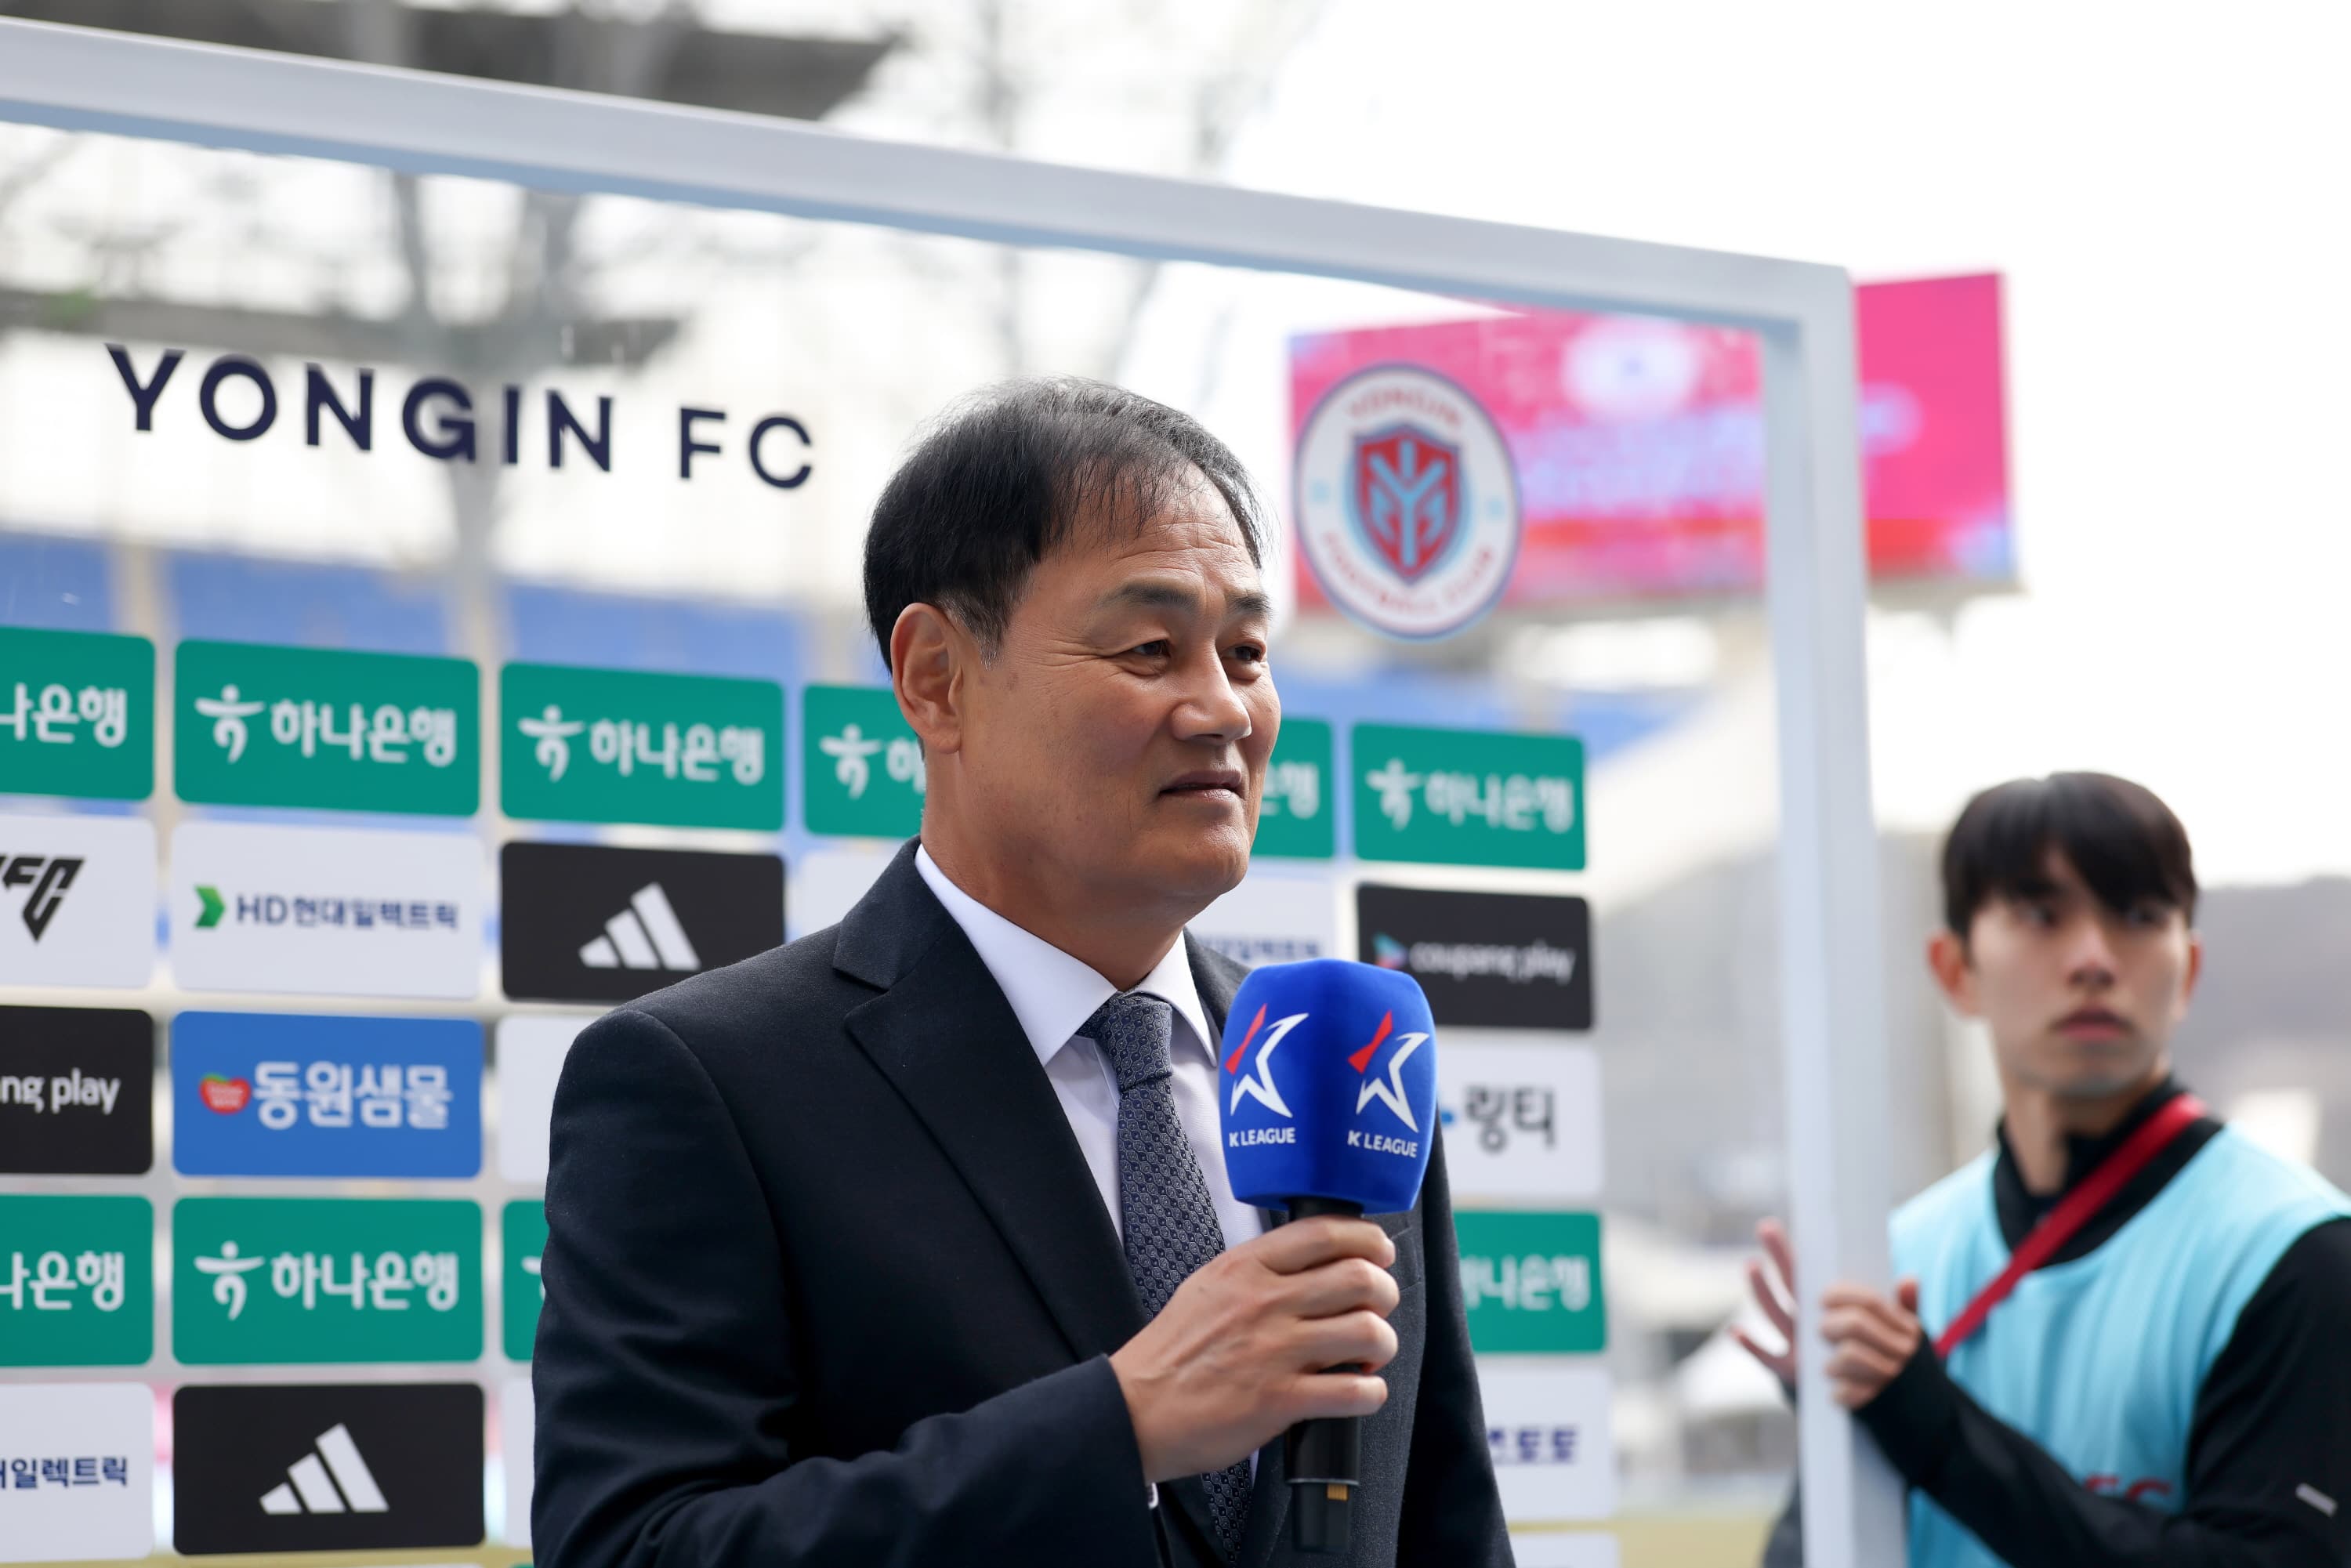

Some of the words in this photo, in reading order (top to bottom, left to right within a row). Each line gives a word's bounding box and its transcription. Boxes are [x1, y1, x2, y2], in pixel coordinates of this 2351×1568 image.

[106, 342, 614, 474] YONGIN
[679, 407, 813, 489] FC
[271, 700, 457, 766] 하나은행
[589, 718, 765, 786] 하나은행
[1424, 770, 1574, 833] 하나은행
[51, 1066, 121, 1115] play
[252, 1060, 455, 1130] 동원샘물
[1464, 1084, 1556, 1155] 링티
[1229, 1132, 1241, 1147] K
[1241, 1127, 1296, 1146] LEAGUE
[1347, 1129, 1362, 1147] K
[1364, 1132, 1418, 1158] LEAGUE
[271, 1251, 459, 1312] 하나은행
